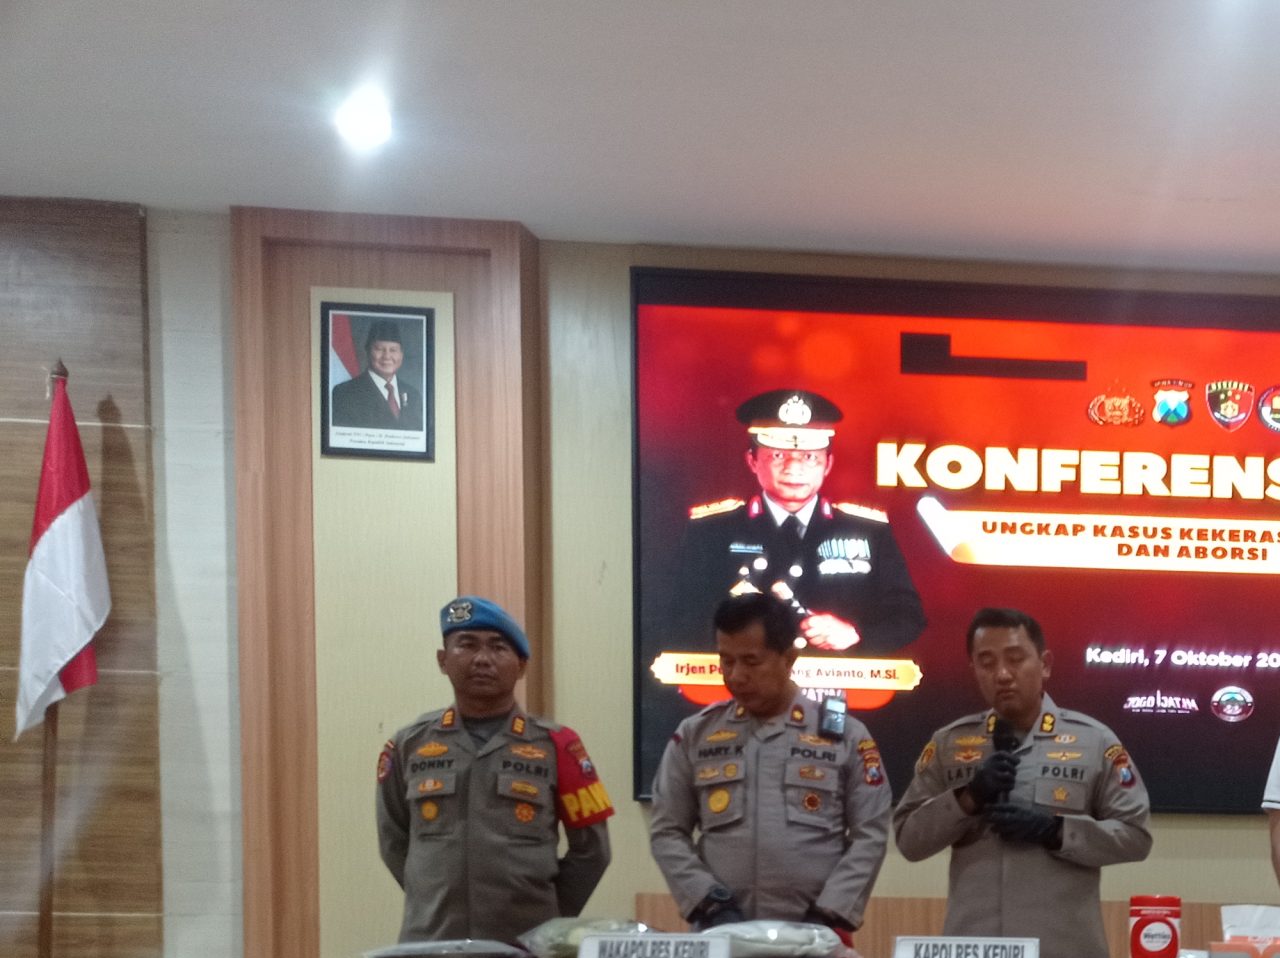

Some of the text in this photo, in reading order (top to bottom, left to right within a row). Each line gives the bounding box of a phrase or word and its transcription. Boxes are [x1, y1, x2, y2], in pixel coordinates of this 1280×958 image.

[982, 521, 1086, 537] UNGKAP
[1093, 525, 1173, 541] KASUS
[1117, 543, 1268, 561] DAN ABORSI
[1086, 648, 1150, 668] Kediri,
[1154, 650, 1168, 665] 7
[1171, 650, 1253, 668] Oktober
[675, 663, 706, 676] Irjen
[791, 746, 836, 762] POLRI
[1042, 766, 1084, 781] POLRI
